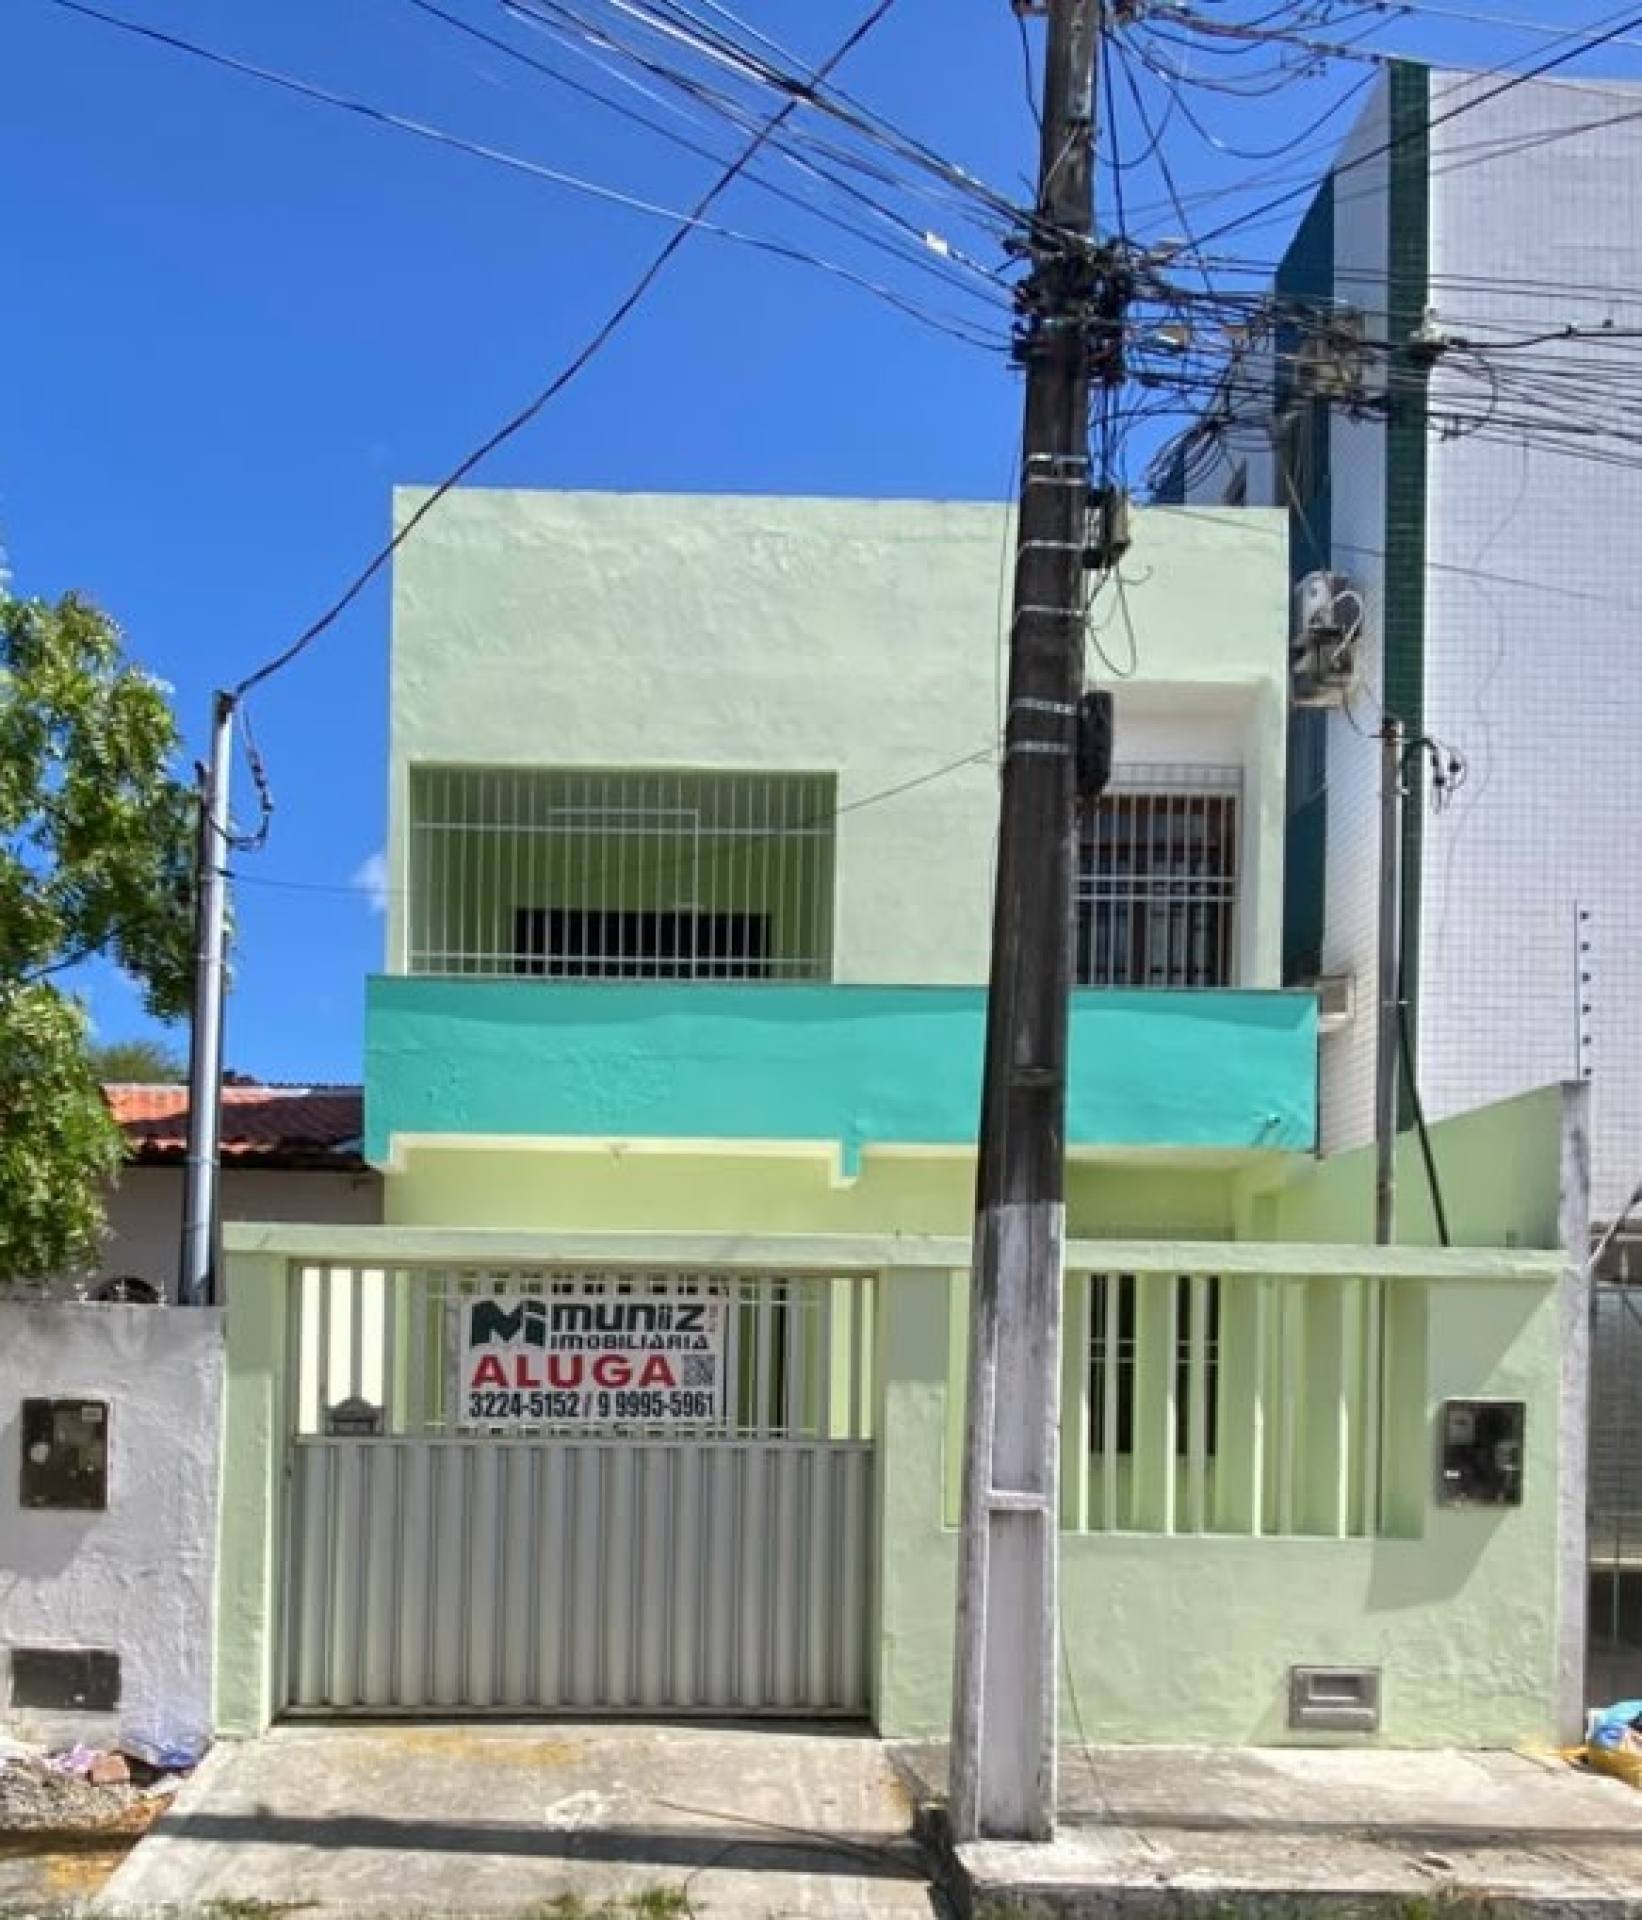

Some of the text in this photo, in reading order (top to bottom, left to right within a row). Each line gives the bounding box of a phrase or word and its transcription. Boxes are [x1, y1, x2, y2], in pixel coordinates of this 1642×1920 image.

[471, 1354, 677, 1389] ALUGA
[469, 1391, 580, 1418] 3224-5152
[599, 1391, 610, 1418] 9
[615, 1391, 714, 1418] 9995-5961
